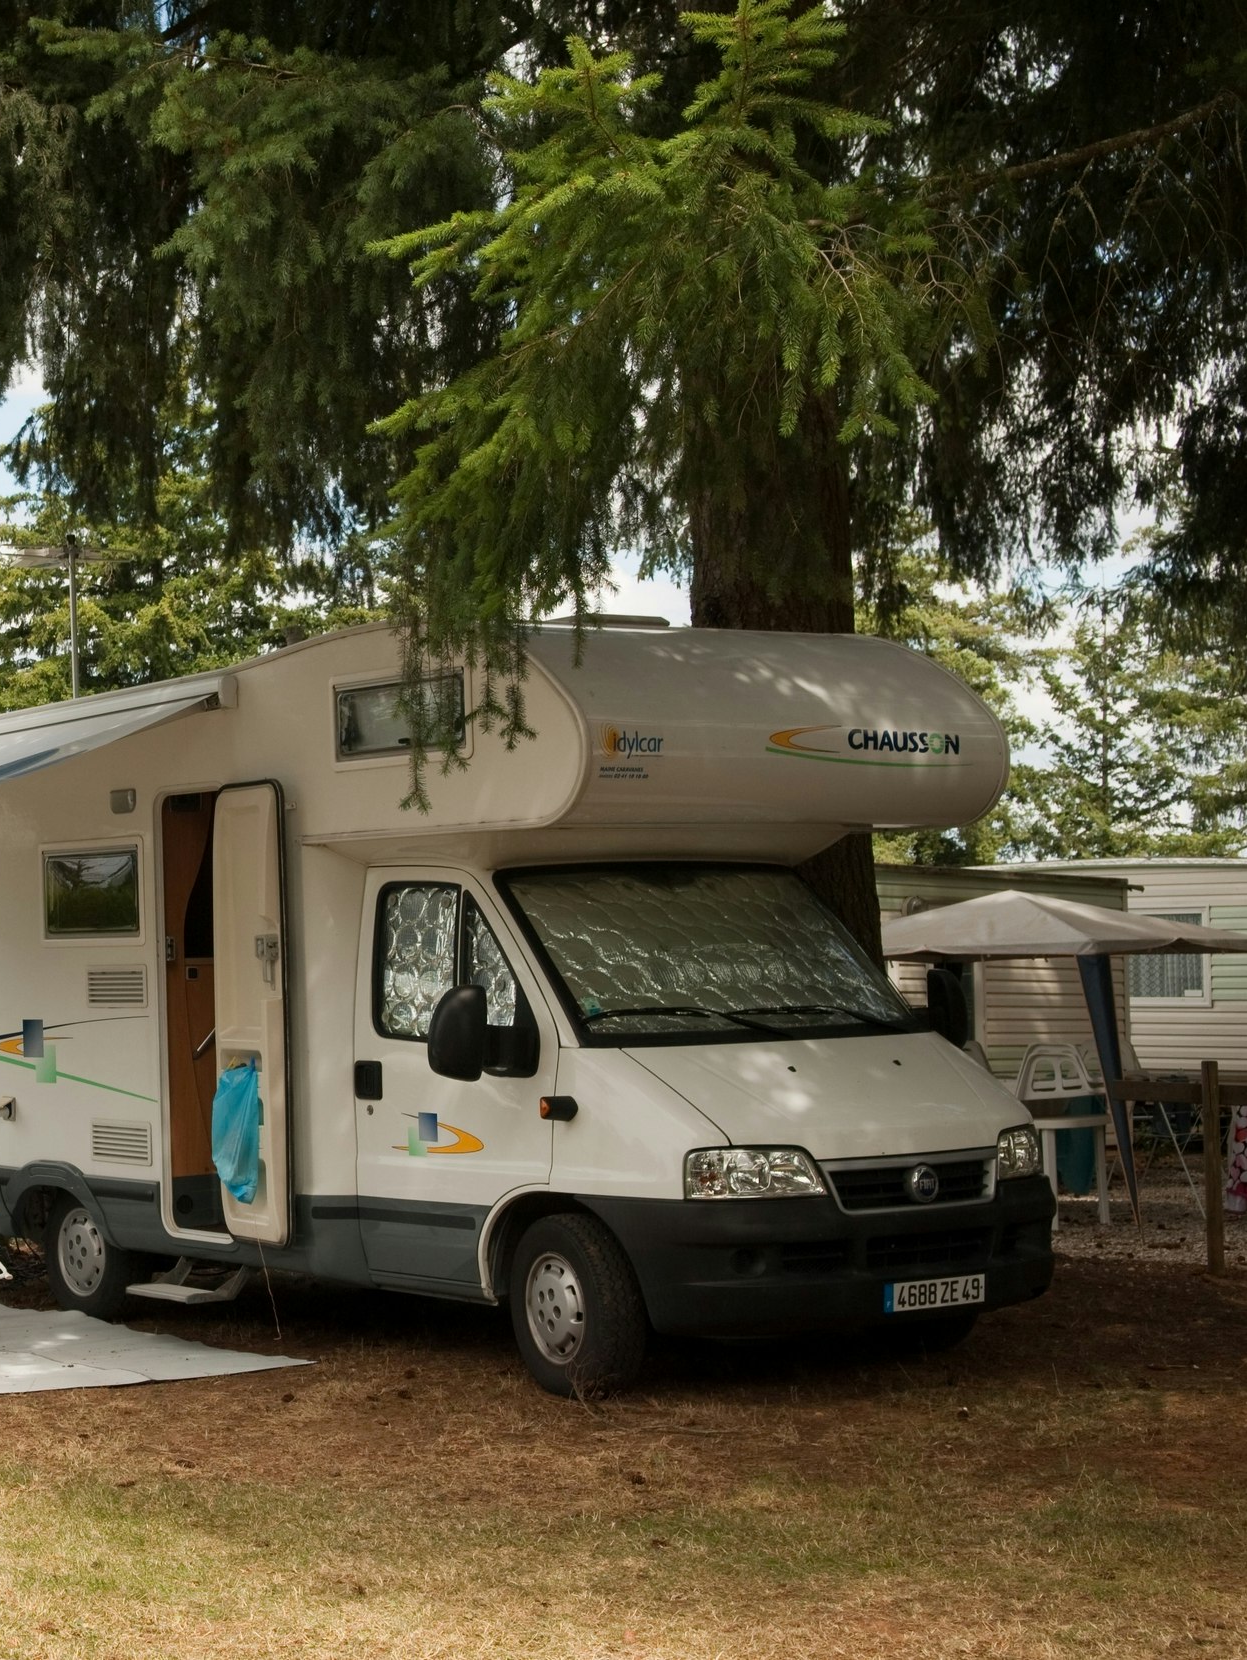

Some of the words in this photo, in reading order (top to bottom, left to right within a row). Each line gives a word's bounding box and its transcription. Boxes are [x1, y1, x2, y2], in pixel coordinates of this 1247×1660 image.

[613, 730, 664, 760] idylcar
[847, 728, 960, 755] CHAUSSON
[919, 1178, 935, 1190] FIAT
[897, 1282, 938, 1308] 4688
[940, 1279, 959, 1304] ZE
[961, 1277, 980, 1301] 49
